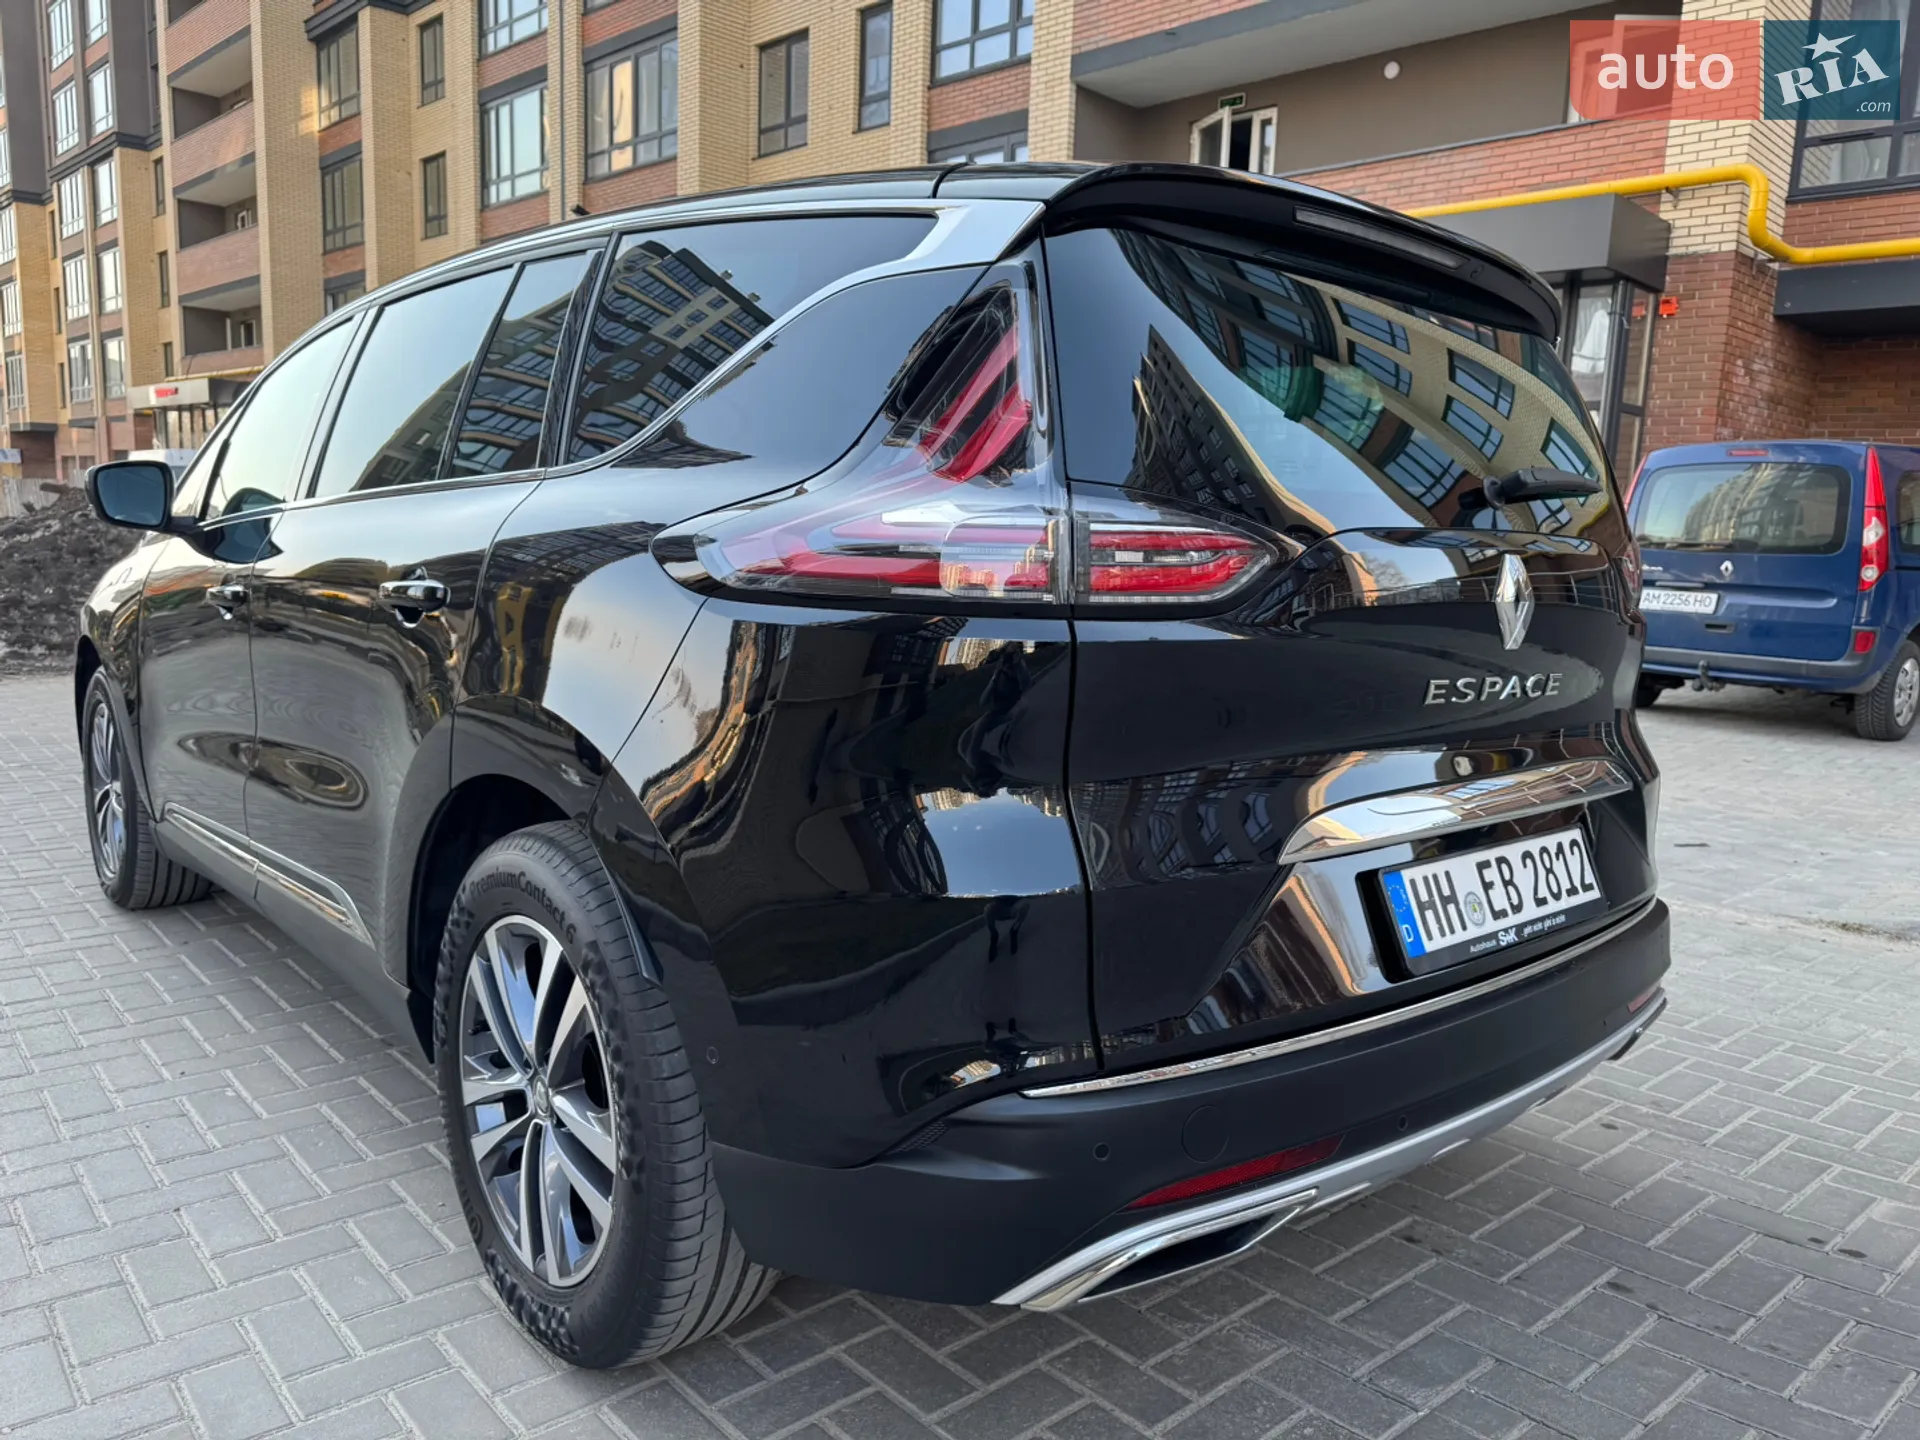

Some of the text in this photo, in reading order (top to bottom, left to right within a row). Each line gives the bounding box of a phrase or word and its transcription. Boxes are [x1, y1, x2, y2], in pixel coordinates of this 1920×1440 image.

[1642, 592, 1660, 605] AM
[1662, 592, 1691, 608] 2256
[1424, 673, 1563, 705] ESPACE
[1409, 838, 1595, 941] HH EB 2812
[469, 866, 577, 945] PremiumContact 6
[1402, 924, 1414, 943] D
[1469, 939, 1497, 953] Autohaus
